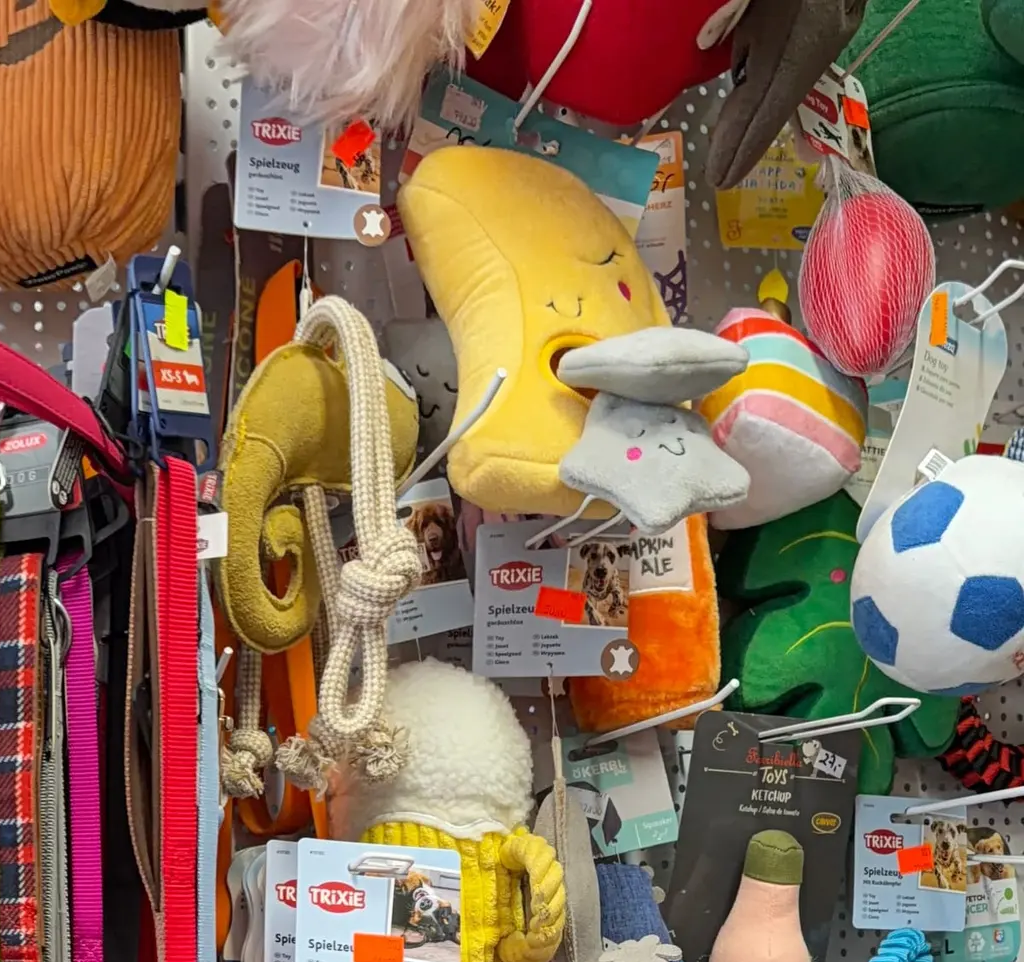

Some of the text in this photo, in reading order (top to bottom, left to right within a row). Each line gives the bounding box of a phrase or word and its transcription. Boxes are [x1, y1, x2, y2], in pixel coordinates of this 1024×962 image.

[249, 157, 300, 173] Spielzeug
[160, 369, 182, 383] XS-S
[4, 435, 41, 451] ZOLUX
[629, 537, 674, 560] MPKIN
[641, 558, 673, 577] ALE
[488, 604, 536, 617] Spielzeu
[448, 629, 472, 638] Spiel
[752, 789, 792, 803] KETCHUP
